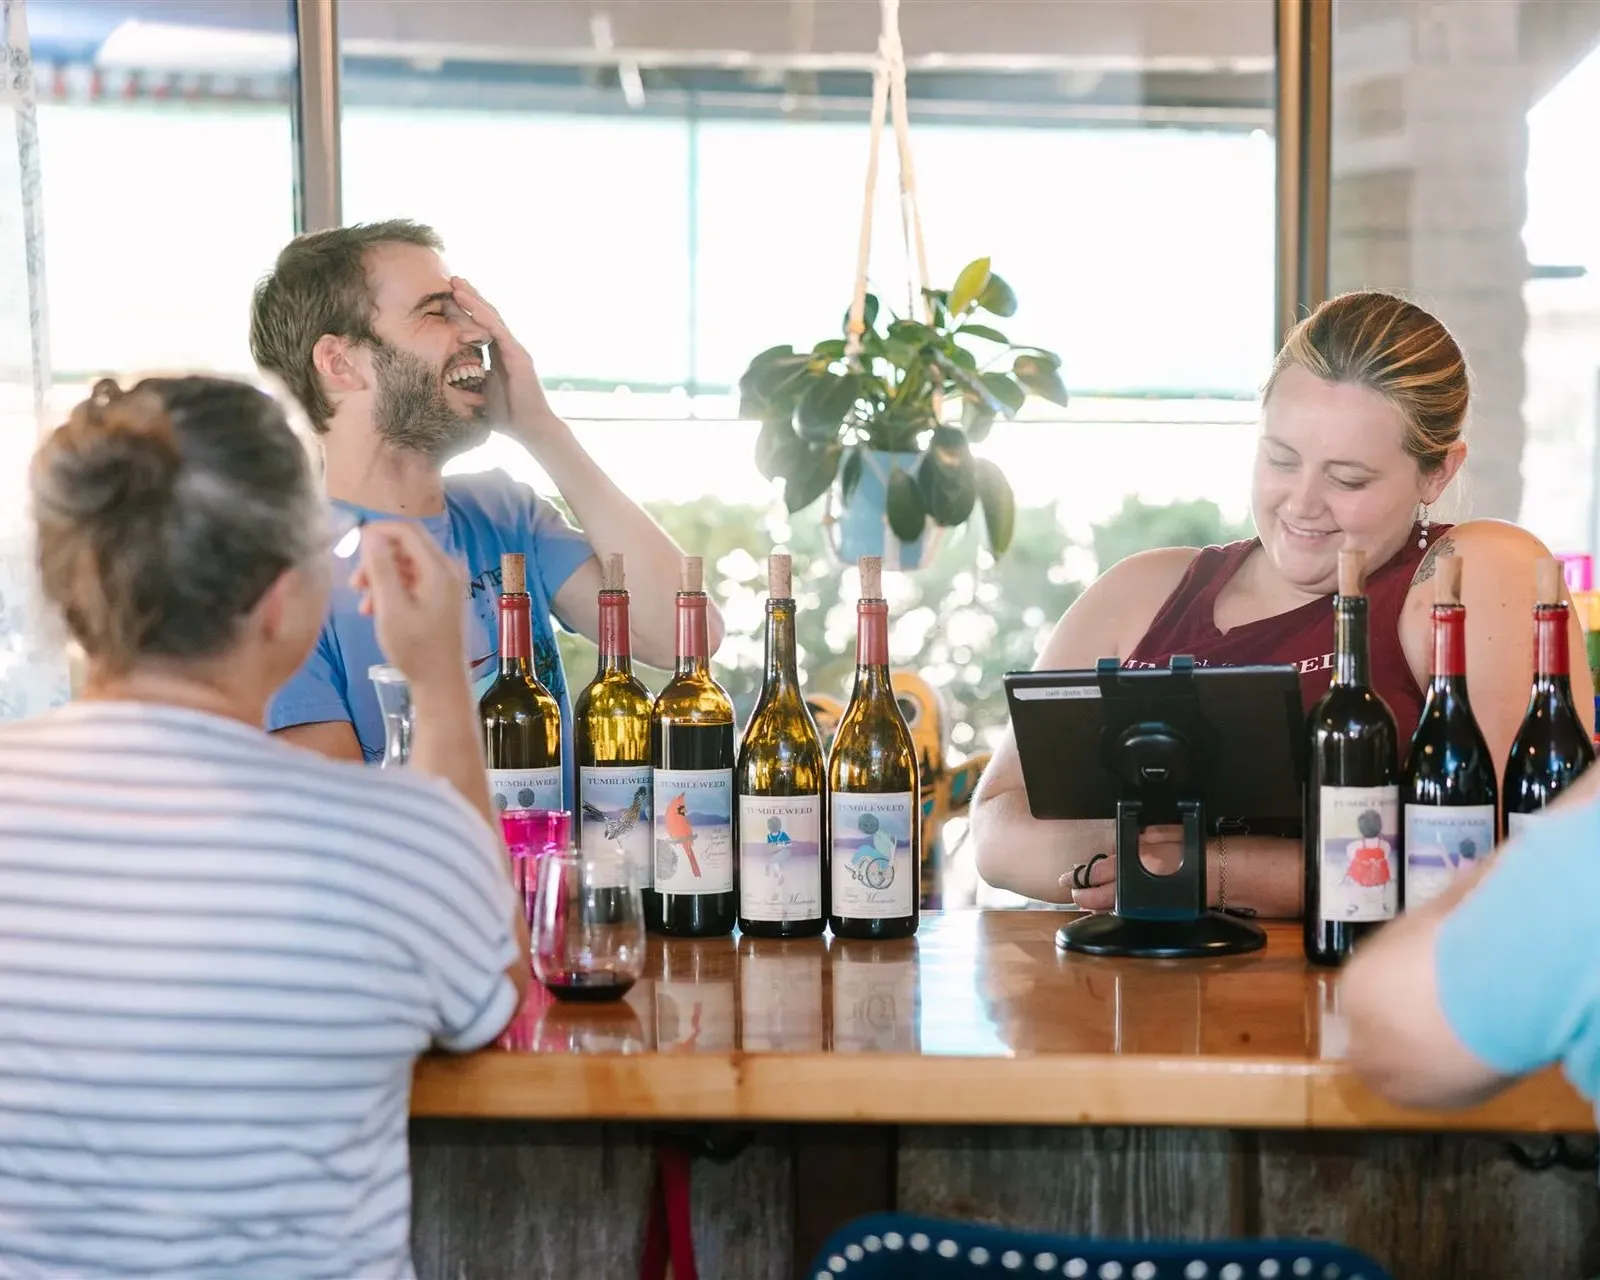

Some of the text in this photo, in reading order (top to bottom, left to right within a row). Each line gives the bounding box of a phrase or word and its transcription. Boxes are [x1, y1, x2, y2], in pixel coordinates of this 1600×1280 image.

[660, 780, 726, 788] TUMBLEWEED
[747, 807, 813, 815] TUMBLEWEED
[837, 804, 905, 812] TUMBLEWEED
